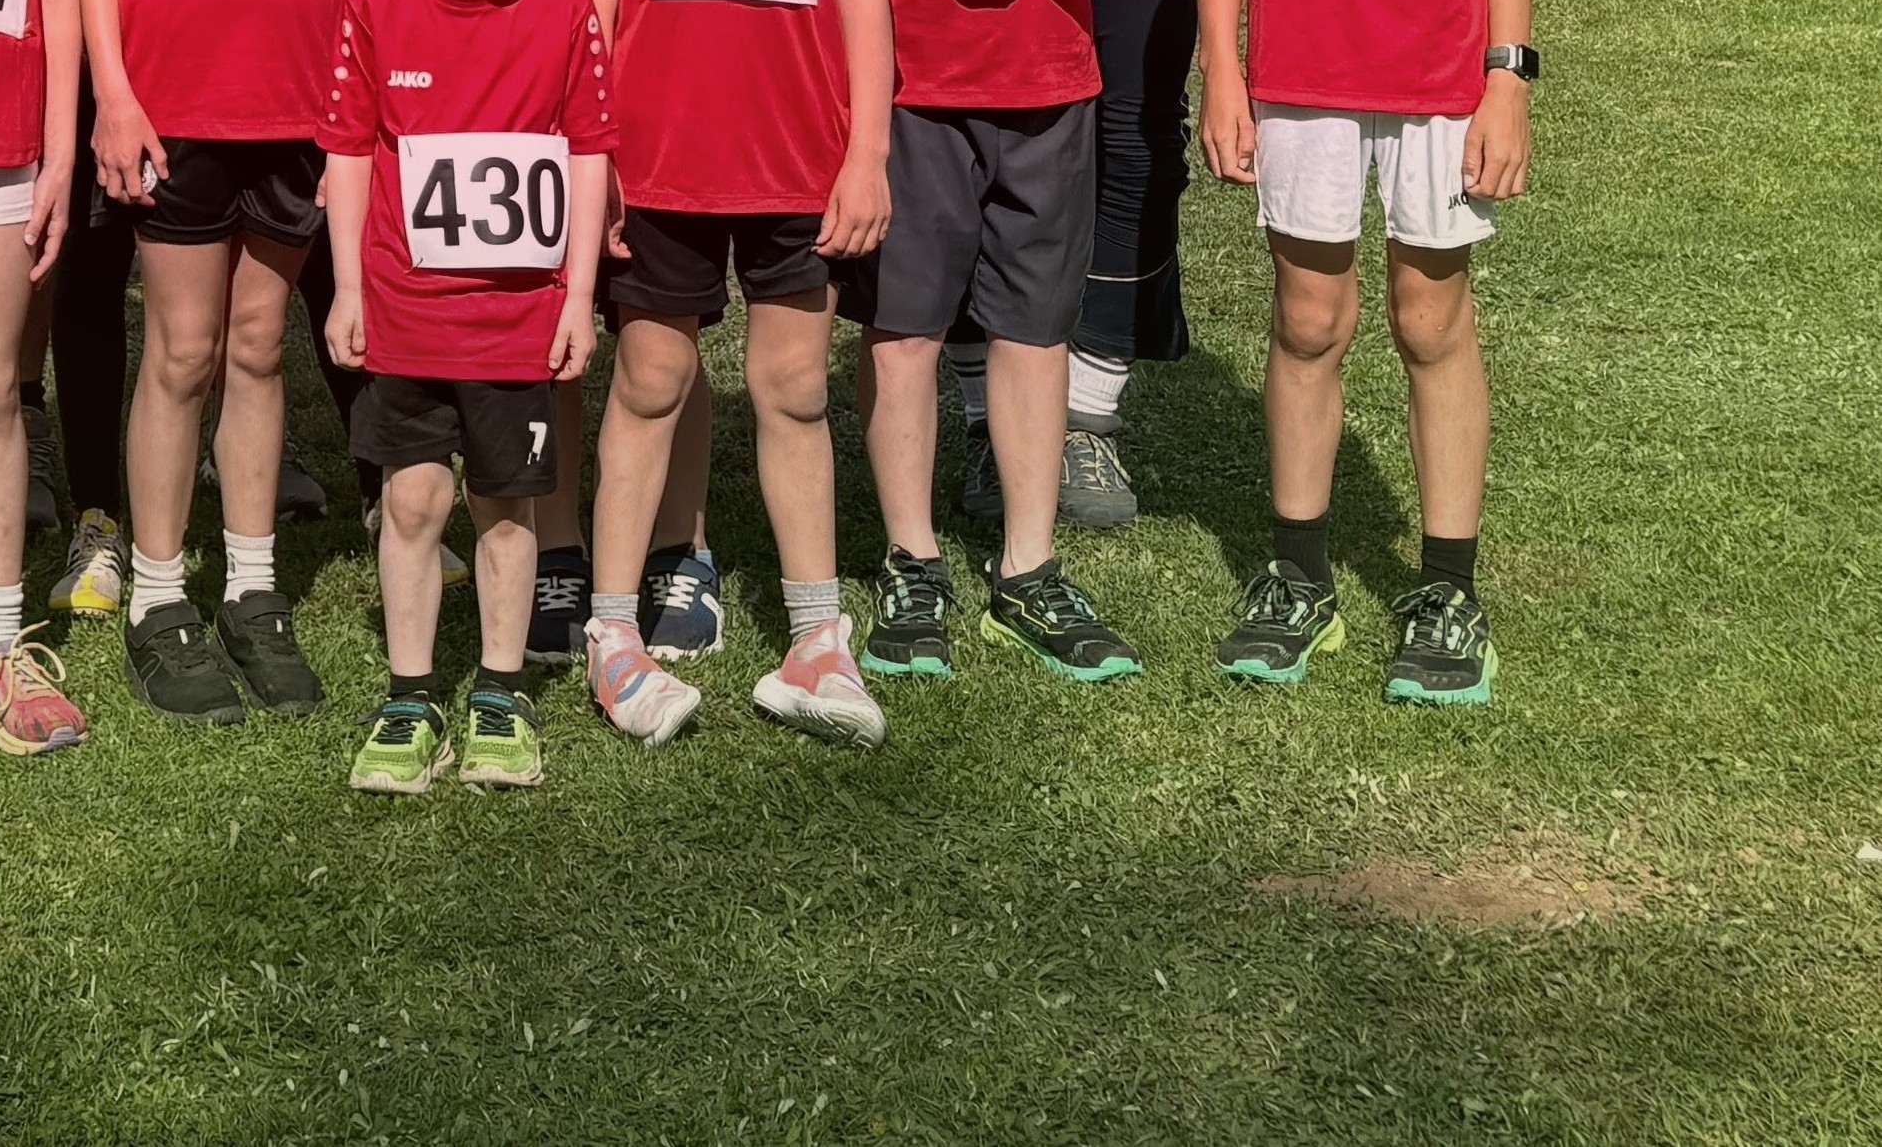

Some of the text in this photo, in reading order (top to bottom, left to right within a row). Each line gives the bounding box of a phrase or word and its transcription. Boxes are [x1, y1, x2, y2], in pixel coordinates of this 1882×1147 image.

[387, 70, 432, 88] JAKO
[411, 156, 565, 248] 430
[526, 421, 547, 465] 7
